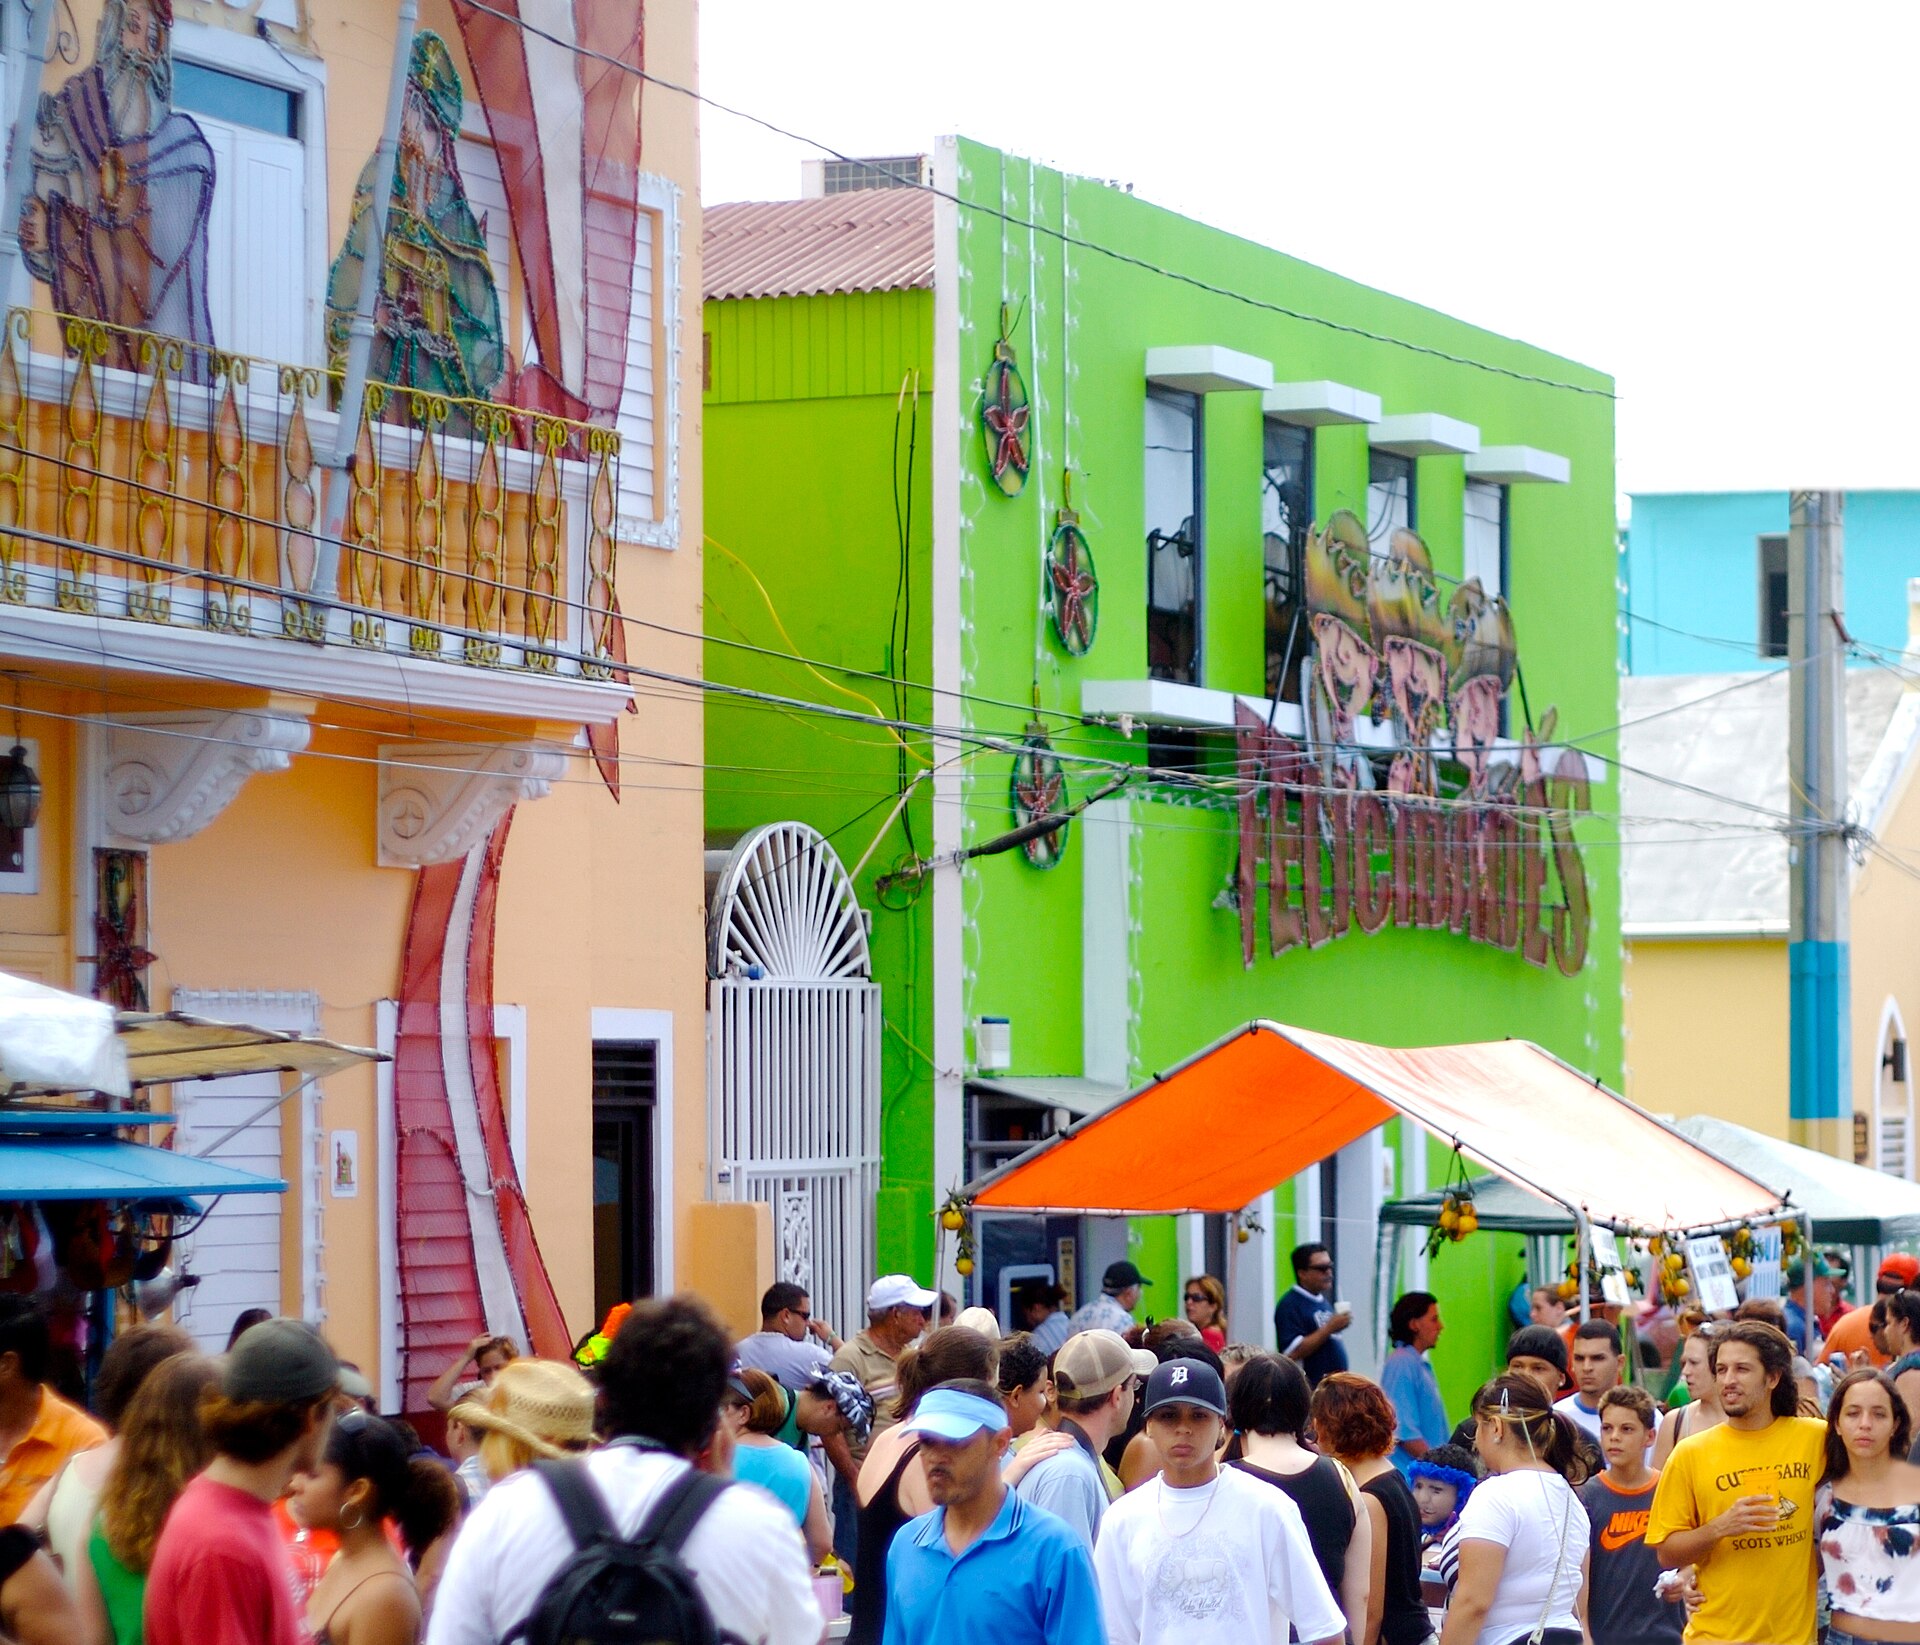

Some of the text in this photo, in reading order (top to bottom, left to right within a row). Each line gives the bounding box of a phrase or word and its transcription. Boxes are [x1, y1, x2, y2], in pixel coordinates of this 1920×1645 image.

[1234, 694, 1590, 978] FELICIDADES
[1170, 1366, 1189, 1387] D
[1716, 1462, 1811, 1492] CUT SARK
[1608, 1511, 1650, 1533] NIKE
[1732, 1530, 1808, 1551] SCOTS WHISKY
